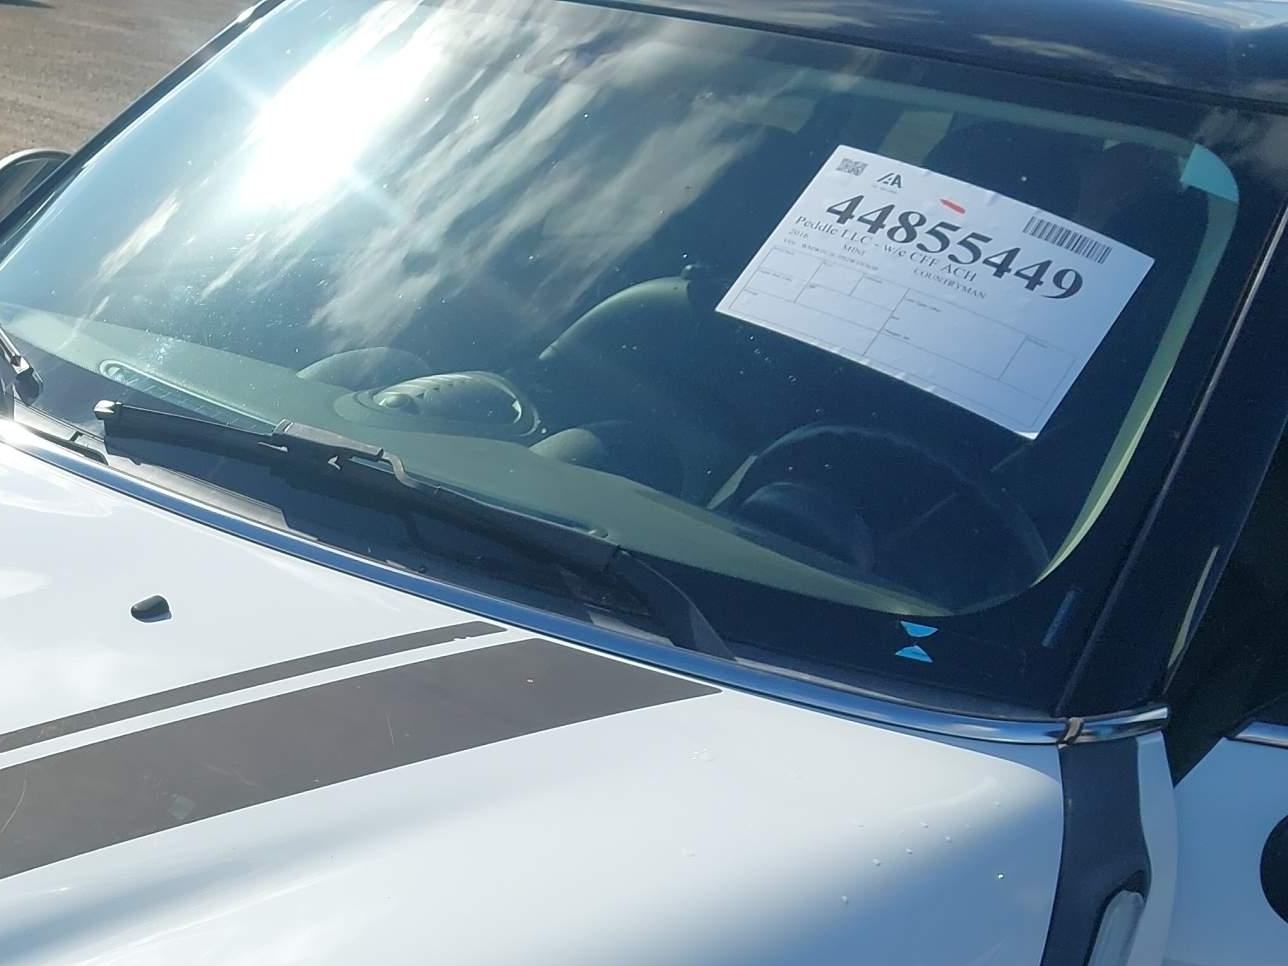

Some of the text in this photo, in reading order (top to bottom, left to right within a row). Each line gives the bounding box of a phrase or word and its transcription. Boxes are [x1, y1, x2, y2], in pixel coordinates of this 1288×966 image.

[795, 215, 839, 235] Peddle
[840, 227, 873, 244] LLC
[940, 262, 978, 282] ACH
[826, 194, 1084, 300] 44855449
[913, 268, 987, 300] COUNTRYMAN
